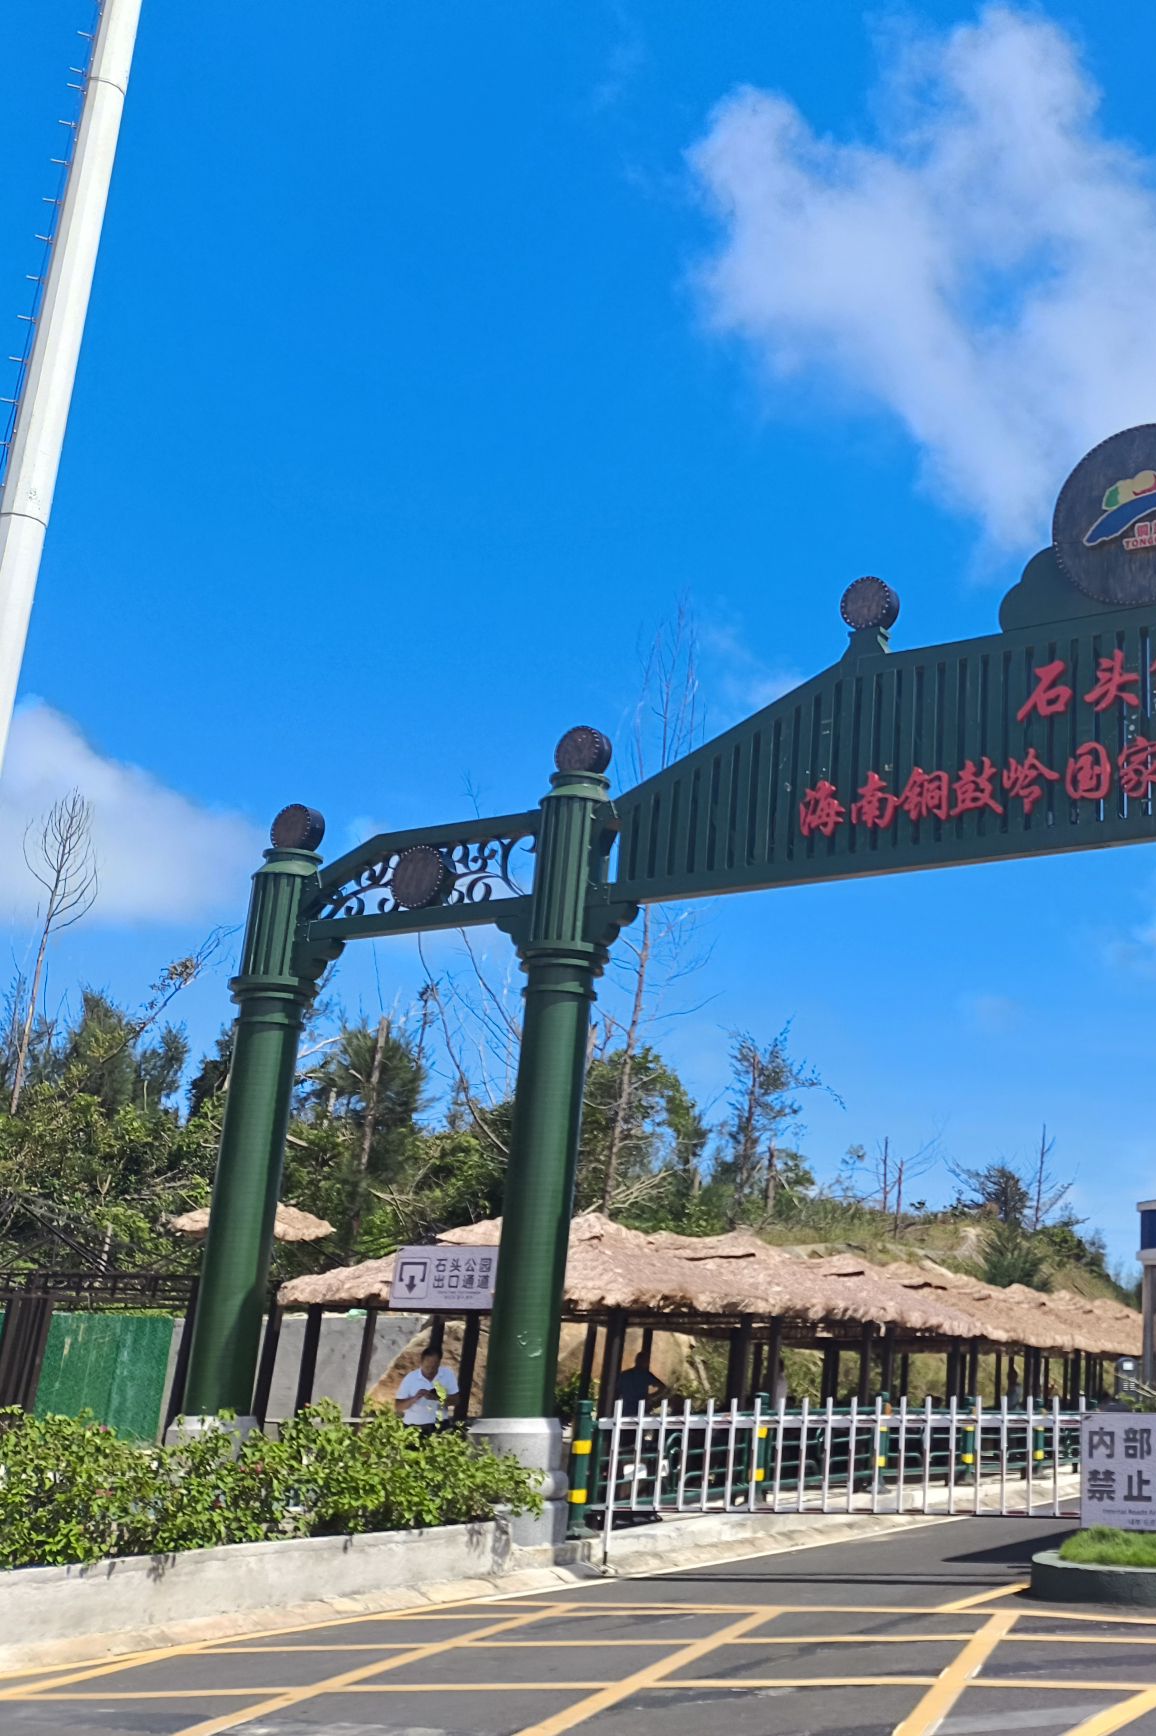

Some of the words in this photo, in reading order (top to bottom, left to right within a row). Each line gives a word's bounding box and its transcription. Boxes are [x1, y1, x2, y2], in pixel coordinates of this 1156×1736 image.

[435, 1258, 492, 1273] 石头公园
[433, 1274, 489, 1289] 出口通道
